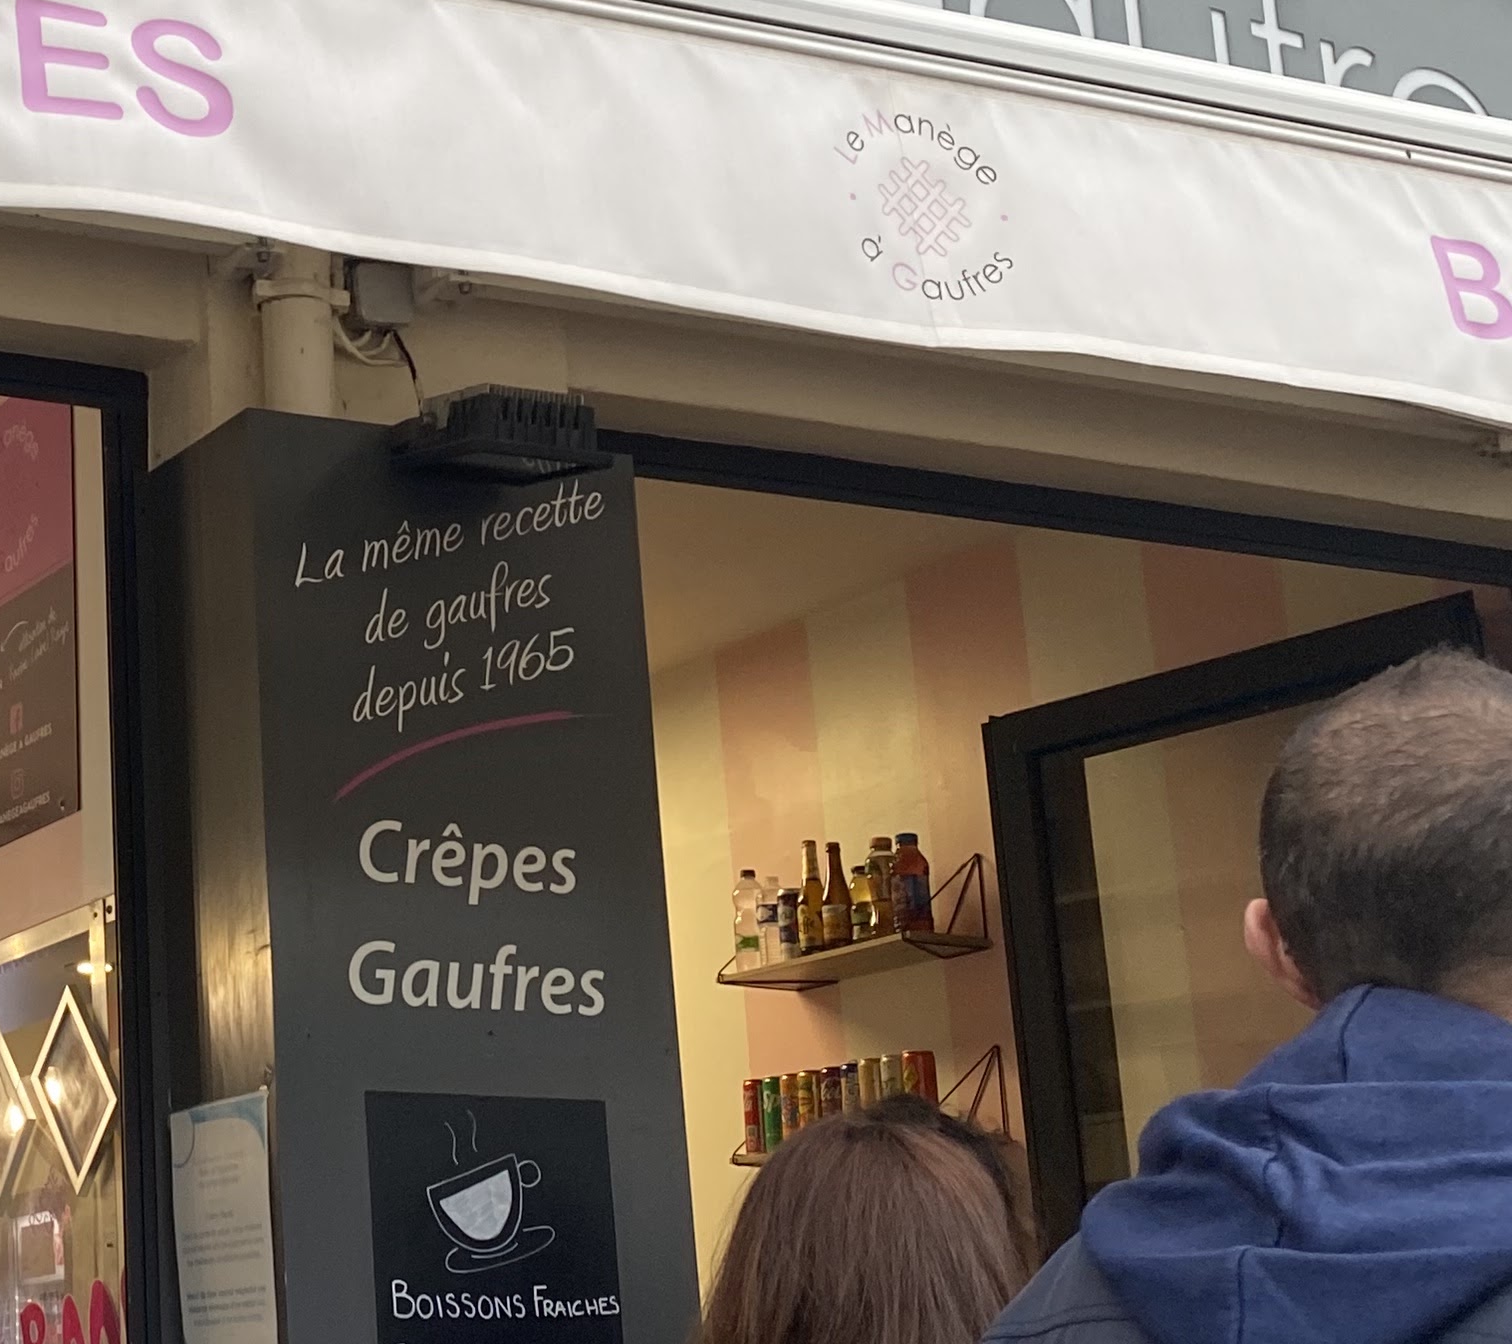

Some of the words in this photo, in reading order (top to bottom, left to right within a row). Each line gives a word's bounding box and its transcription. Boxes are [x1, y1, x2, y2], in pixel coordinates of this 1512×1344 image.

[833, 130, 865, 165] Le
[861, 109, 997, 185] Manège
[891, 251, 1013, 301] Gaufres
[294, 543, 344, 588] La
[361, 520, 464, 573] même
[480, 478, 605, 545] recette
[364, 588, 409, 645] de
[424, 561, 553, 649] gaufres
[352, 652, 466, 732] depuis
[479, 627, 575, 691] 1965
[358, 819, 577, 906] Crêpes
[347, 940, 606, 1016] Gaufres
[391, 1279, 526, 1320] BOISSONS
[533, 1285, 620, 1318] FRAICHES
